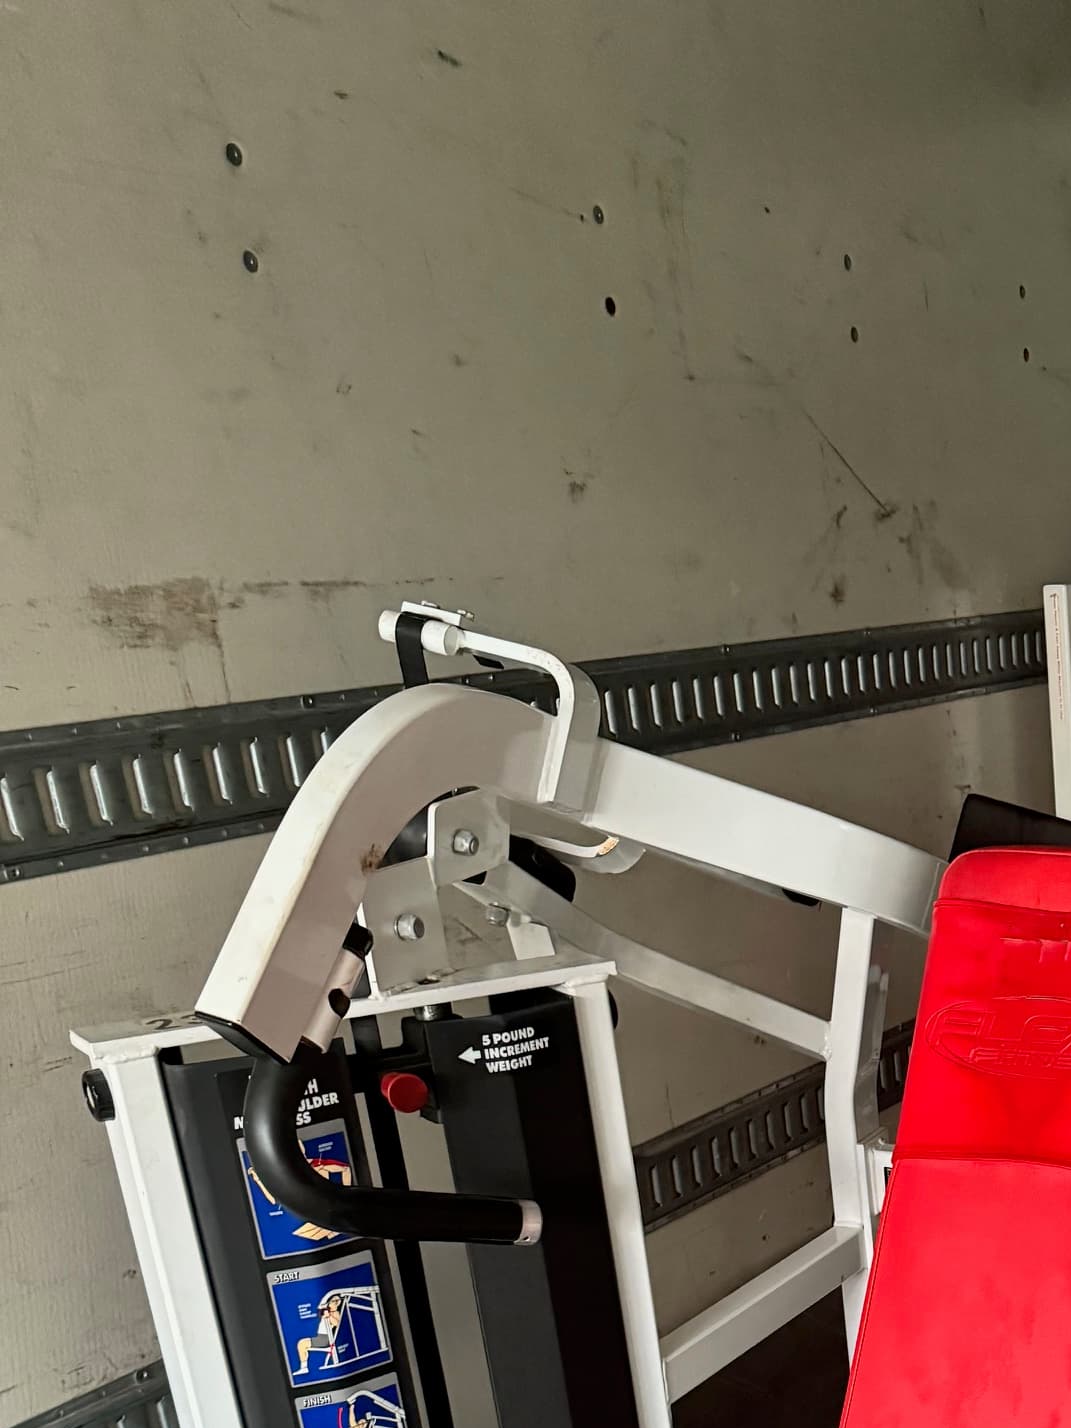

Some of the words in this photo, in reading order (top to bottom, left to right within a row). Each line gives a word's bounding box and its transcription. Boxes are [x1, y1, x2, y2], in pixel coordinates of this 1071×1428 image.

[482, 1034, 491, 1046] 5
[492, 1026, 535, 1044] POUND
[484, 1036, 549, 1060] INCREMENT
[485, 1054, 533, 1074] WEIGHT
[274, 1271, 300, 1283] START
[303, 1394, 332, 1408] FINISH
